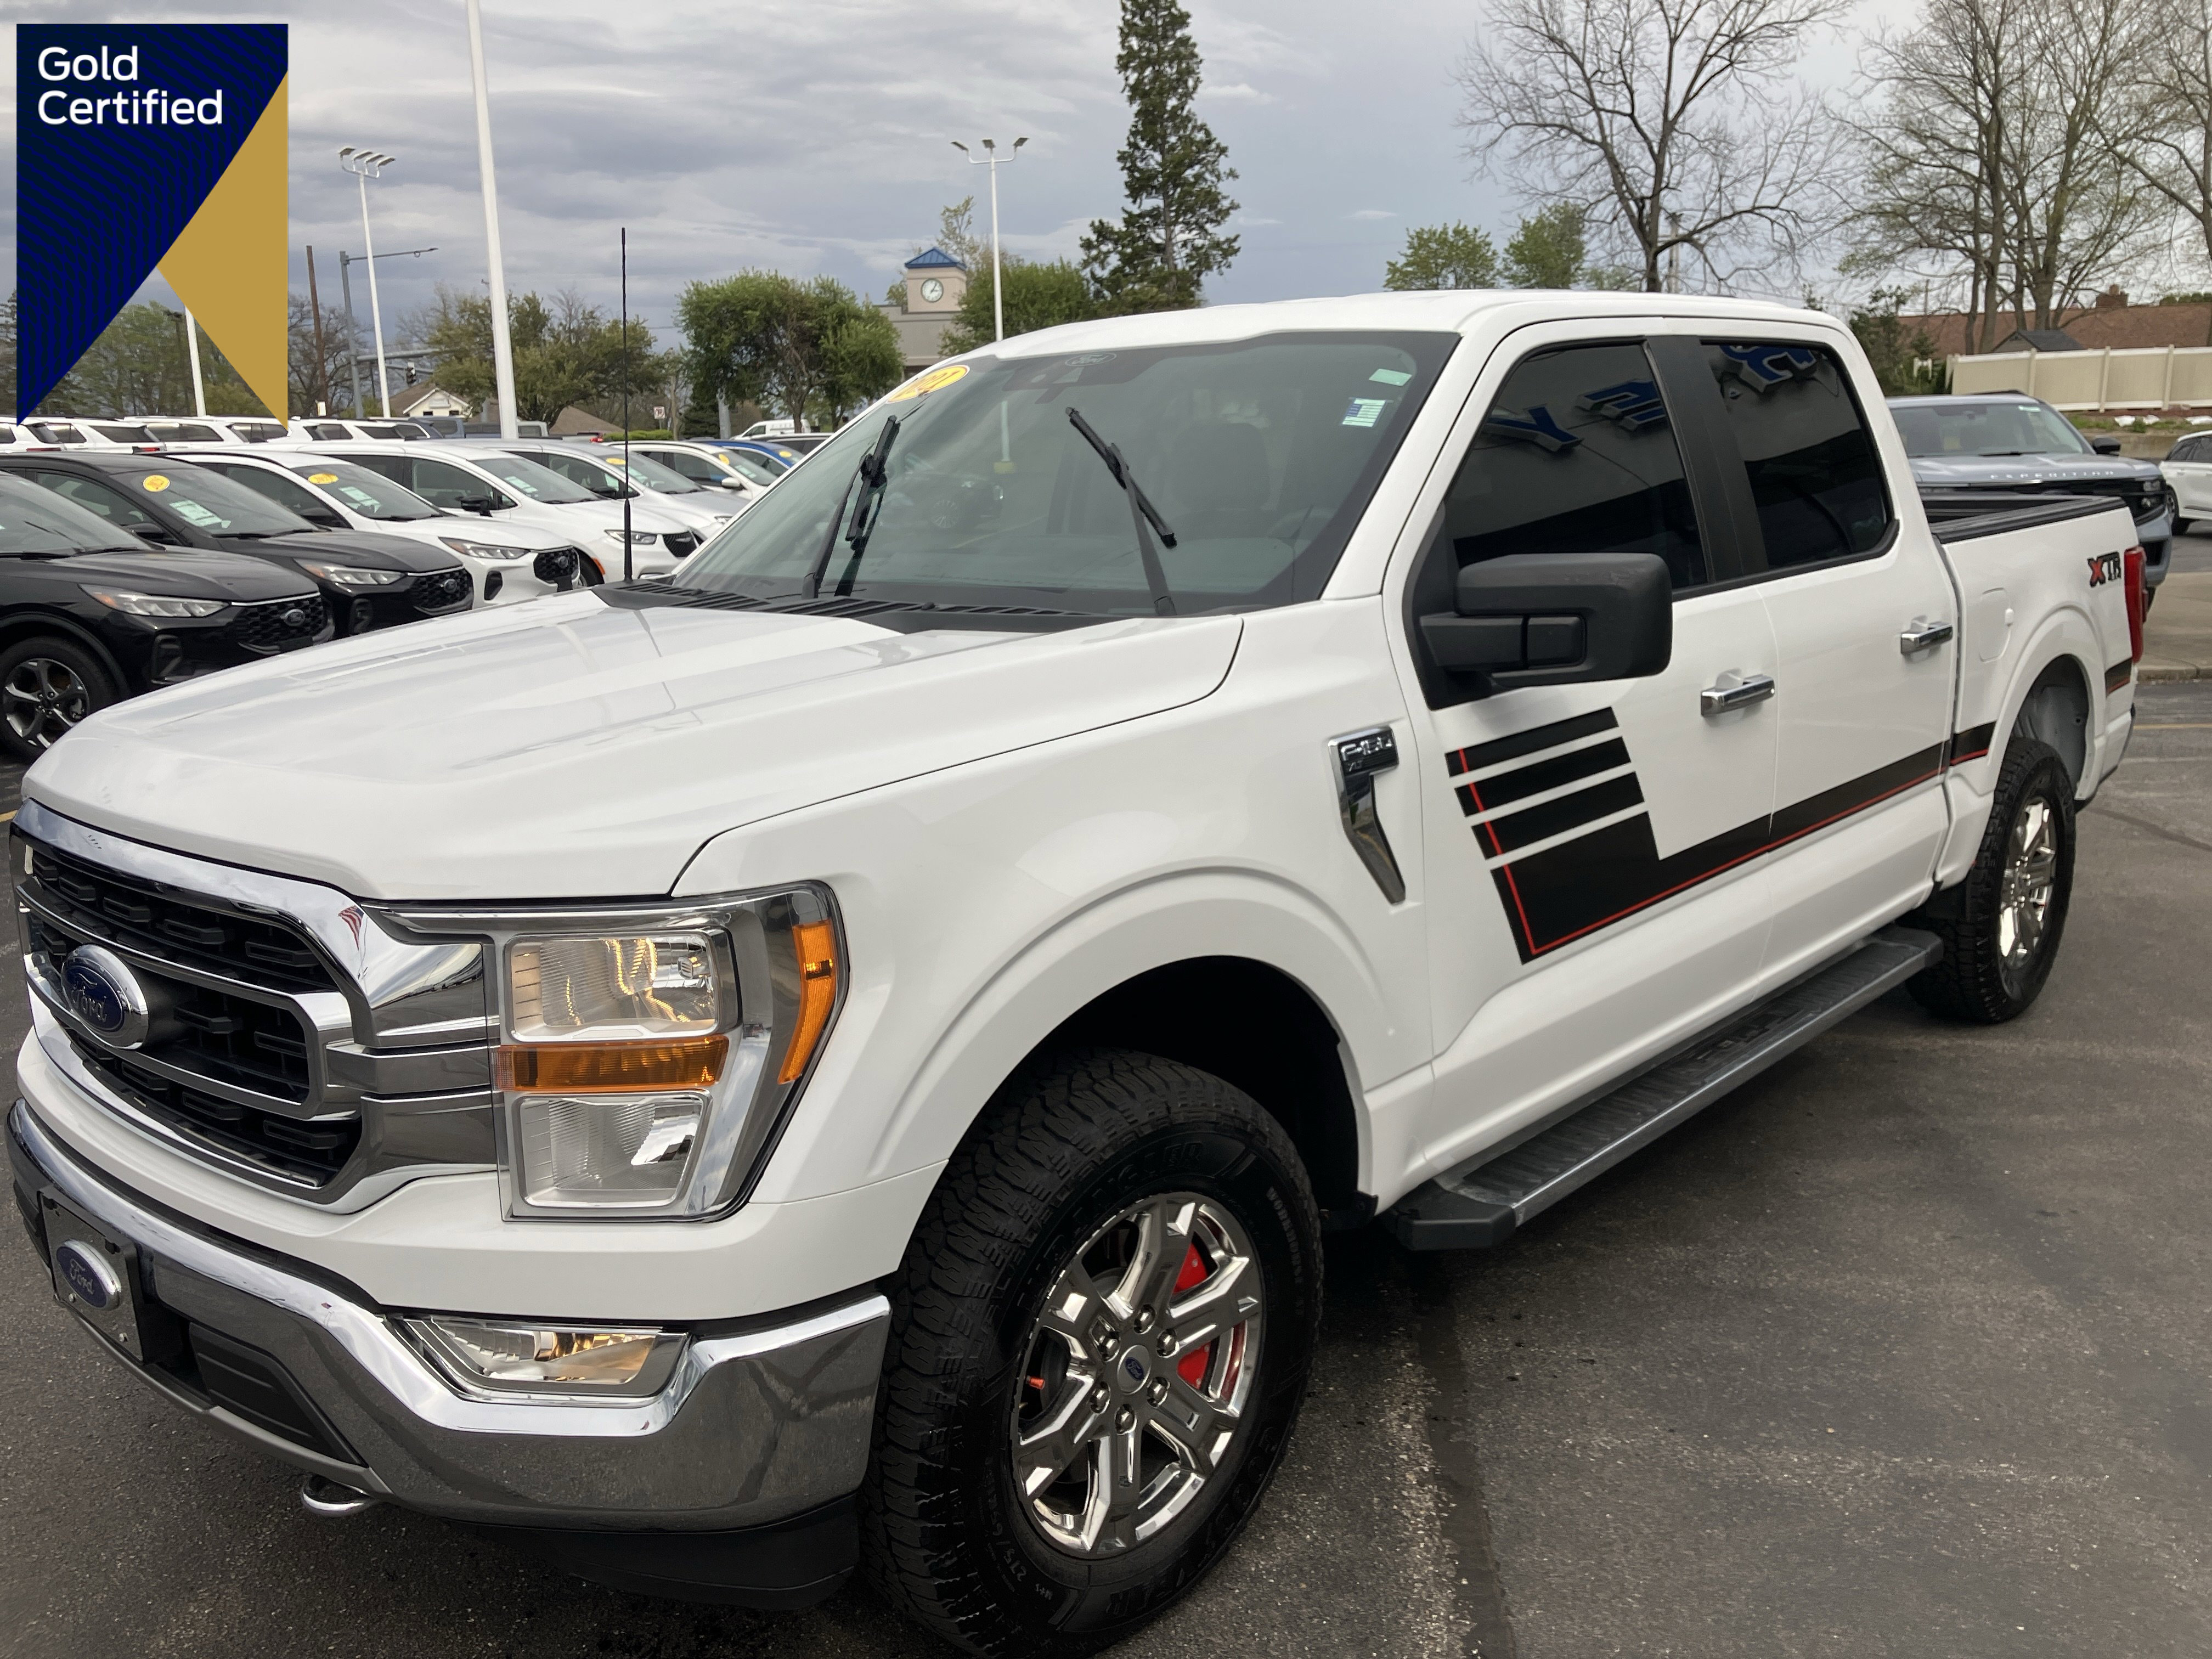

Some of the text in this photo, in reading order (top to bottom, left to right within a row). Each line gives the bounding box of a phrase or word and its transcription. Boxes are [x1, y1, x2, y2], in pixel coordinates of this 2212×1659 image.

[1990, 470, 2114, 480] EXPEDITION
[2087, 551, 2121, 588] XTR
[70, 973, 108, 1023] Ford
[70, 1258, 95, 1295] Ford
